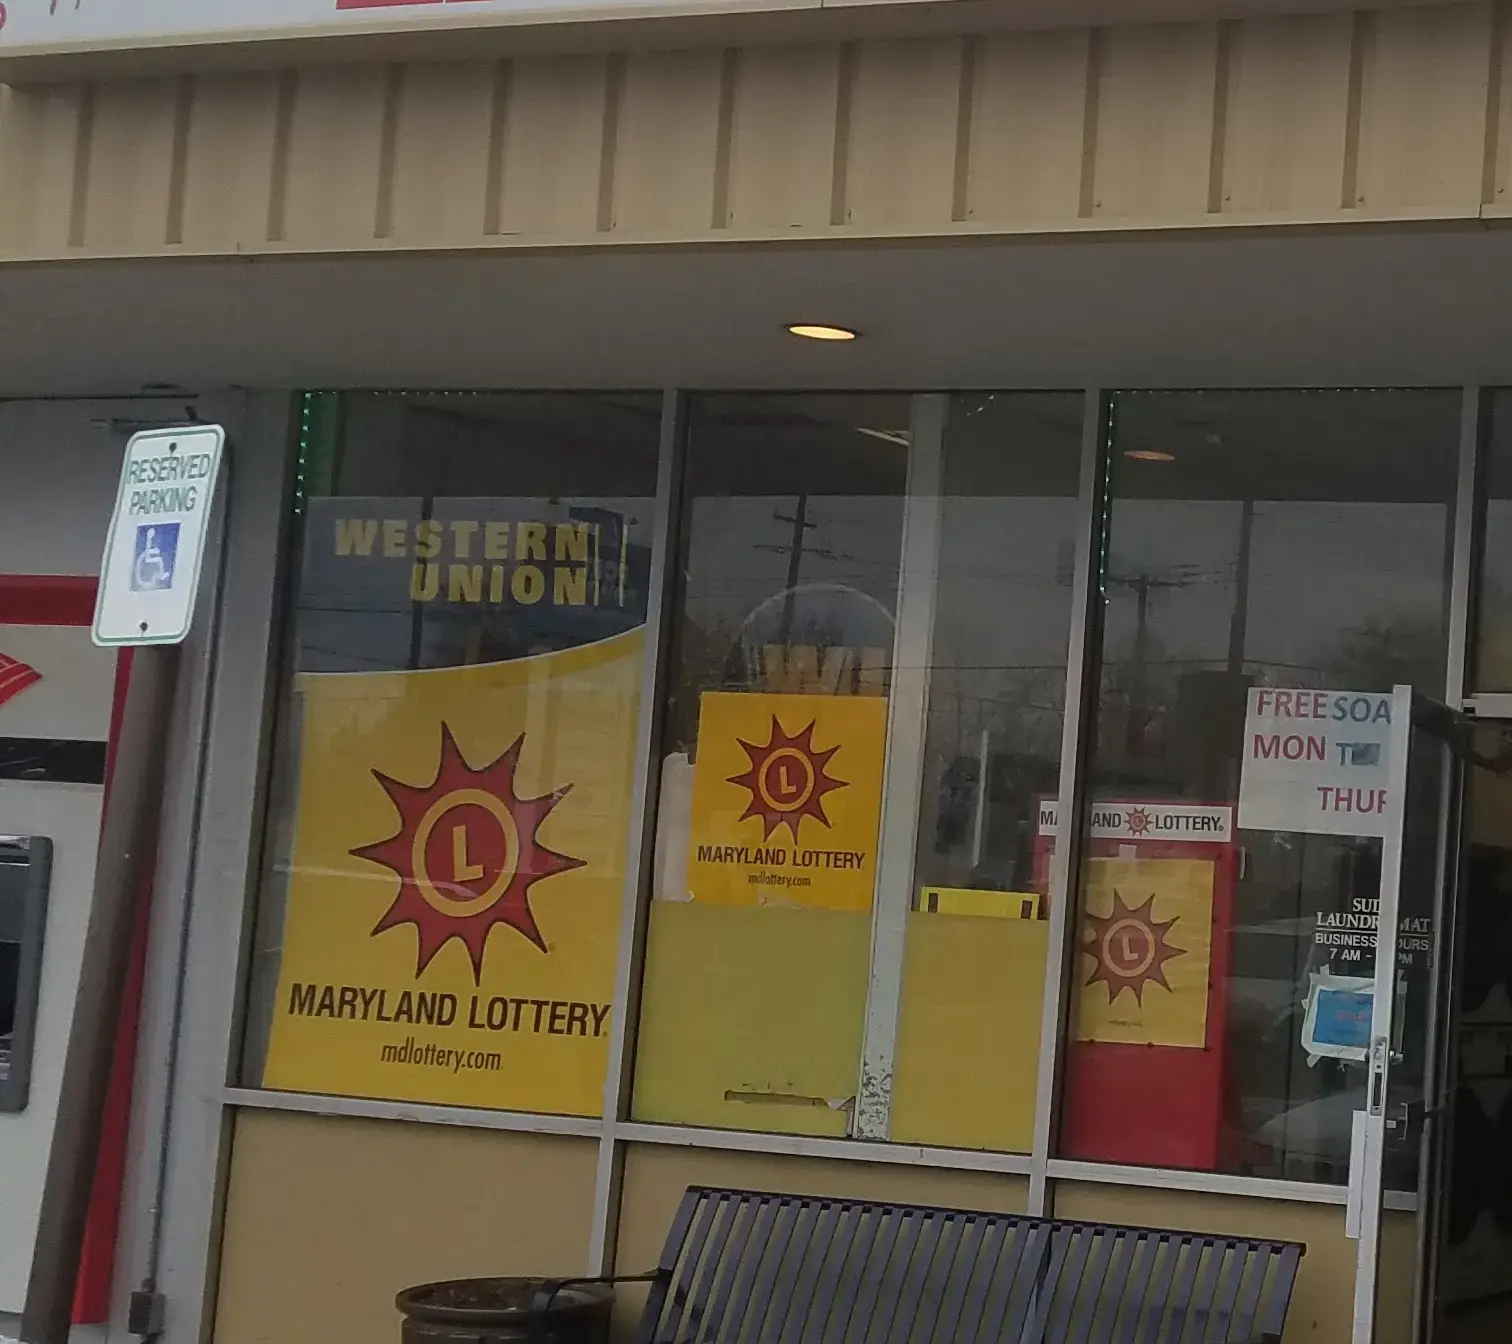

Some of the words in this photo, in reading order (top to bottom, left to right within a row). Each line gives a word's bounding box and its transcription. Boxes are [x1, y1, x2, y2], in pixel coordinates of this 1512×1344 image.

[126, 453, 211, 485] RESERVED
[129, 485, 198, 516] PARKING
[333, 518, 590, 561] WESTERN
[409, 562, 588, 607] UNION
[1256, 689, 1329, 720] FREE
[1331, 695, 1392, 725] SOA
[1252, 733, 1326, 762] MON
[1154, 813, 1224, 833] LOTTERY
[697, 845, 787, 867] MARYLAND
[791, 850, 865, 870] LOTTERY
[747, 872, 811, 888] mdlottery.com
[1316, 911, 1431, 933] LAUNDRMAT
[1315, 932, 1378, 948] BUSINESS
[1329, 947, 1338, 960] 7
[1341, 949, 1361, 961] AM
[287, 982, 458, 1027] MARYLAND
[467, 994, 612, 1038] LOTTERY
[380, 1036, 502, 1073] mdlottery.com
